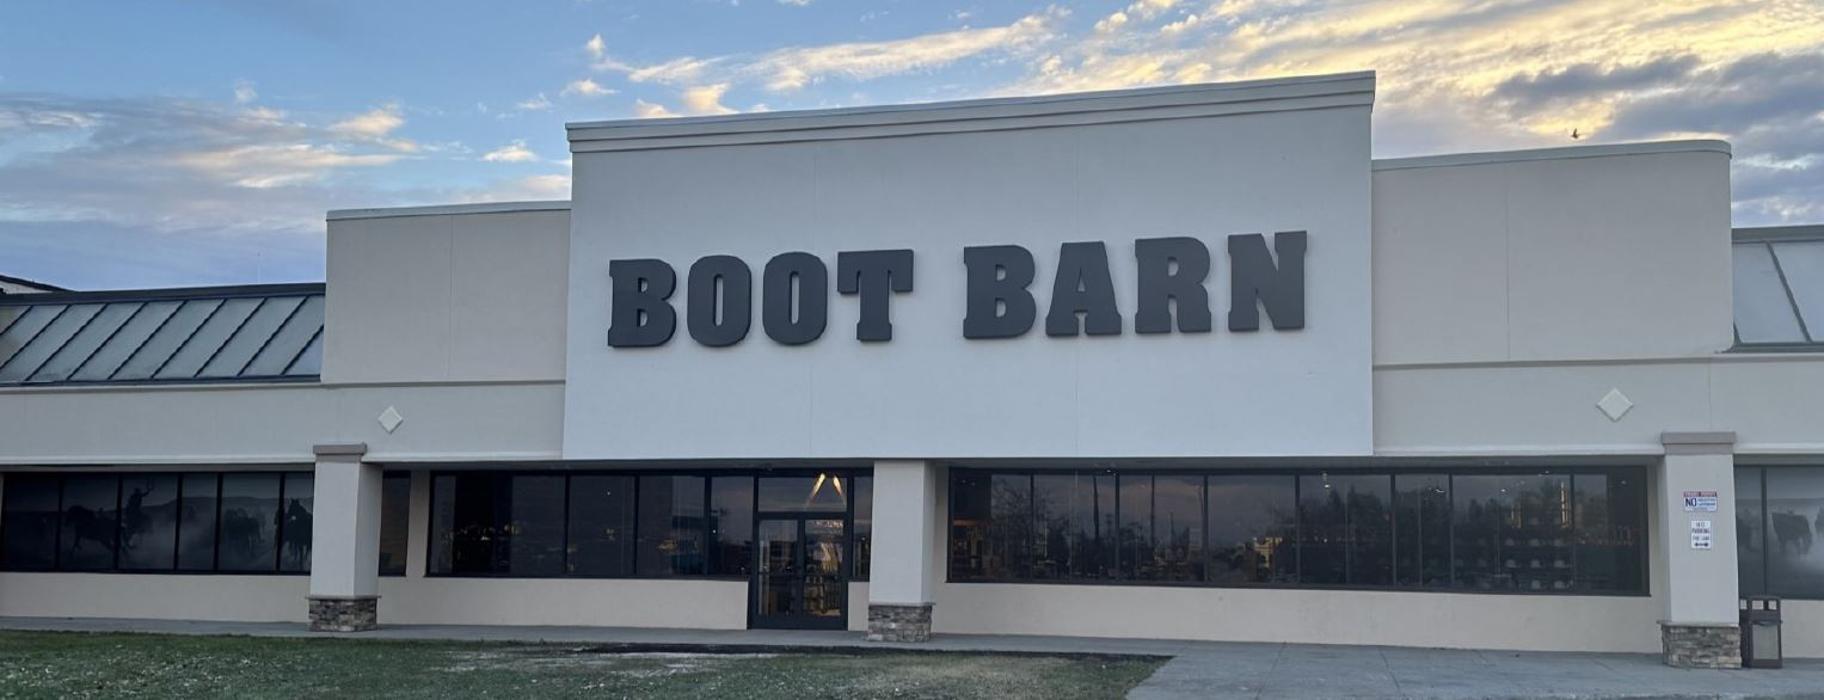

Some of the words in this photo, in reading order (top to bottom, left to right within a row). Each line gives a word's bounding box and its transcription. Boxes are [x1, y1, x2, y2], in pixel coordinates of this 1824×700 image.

[608, 249, 914, 348] BOOT
[963, 230, 1308, 339] BARN
[1685, 497, 1697, 507] NO
